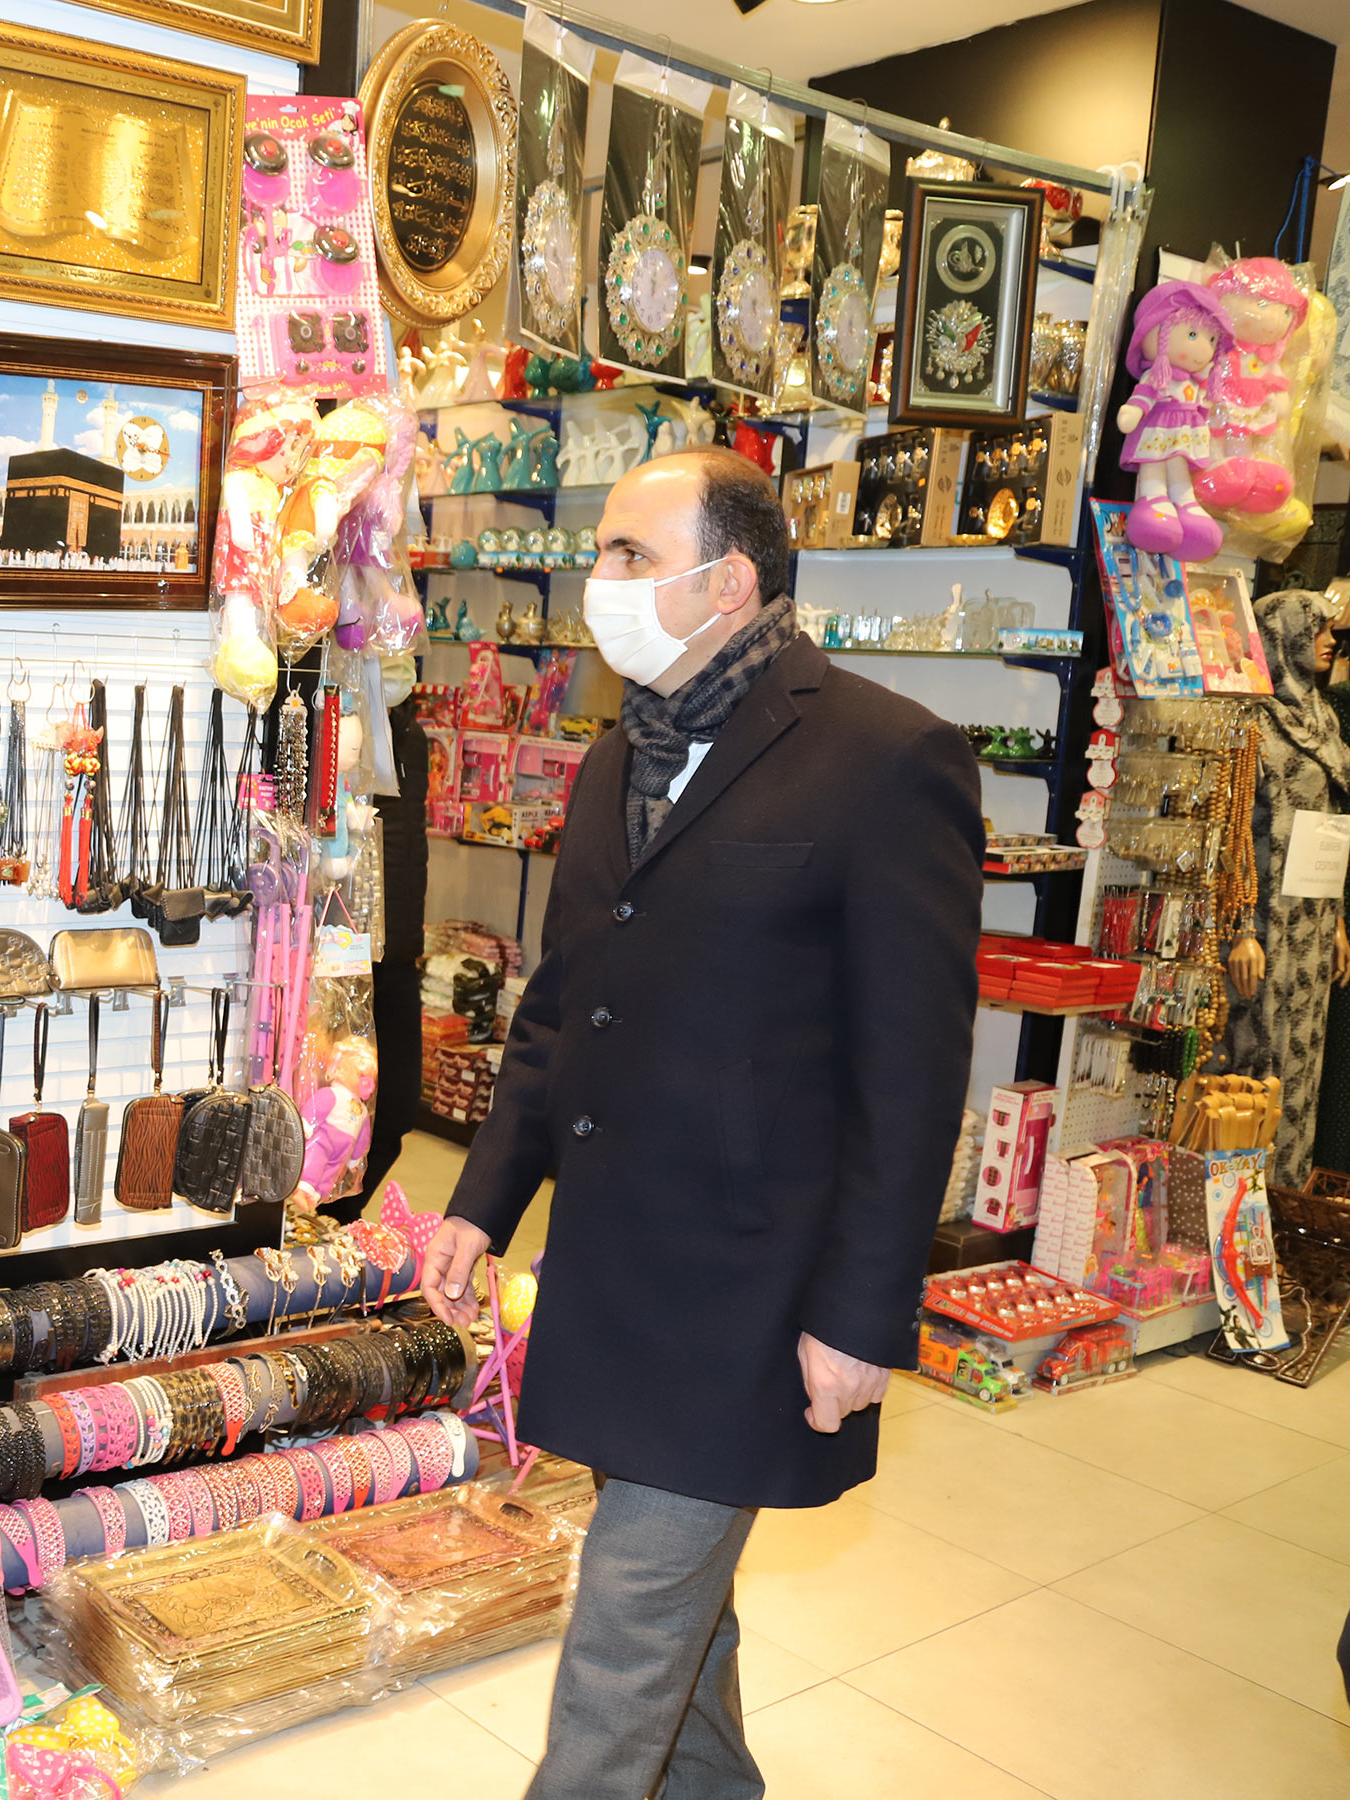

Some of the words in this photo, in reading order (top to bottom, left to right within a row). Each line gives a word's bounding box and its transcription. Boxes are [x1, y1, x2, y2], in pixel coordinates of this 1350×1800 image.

[280, 114, 310, 129] Ocak
[311, 106, 336, 127] Seti
[1210, 1151, 1263, 1177] OK-YAY
